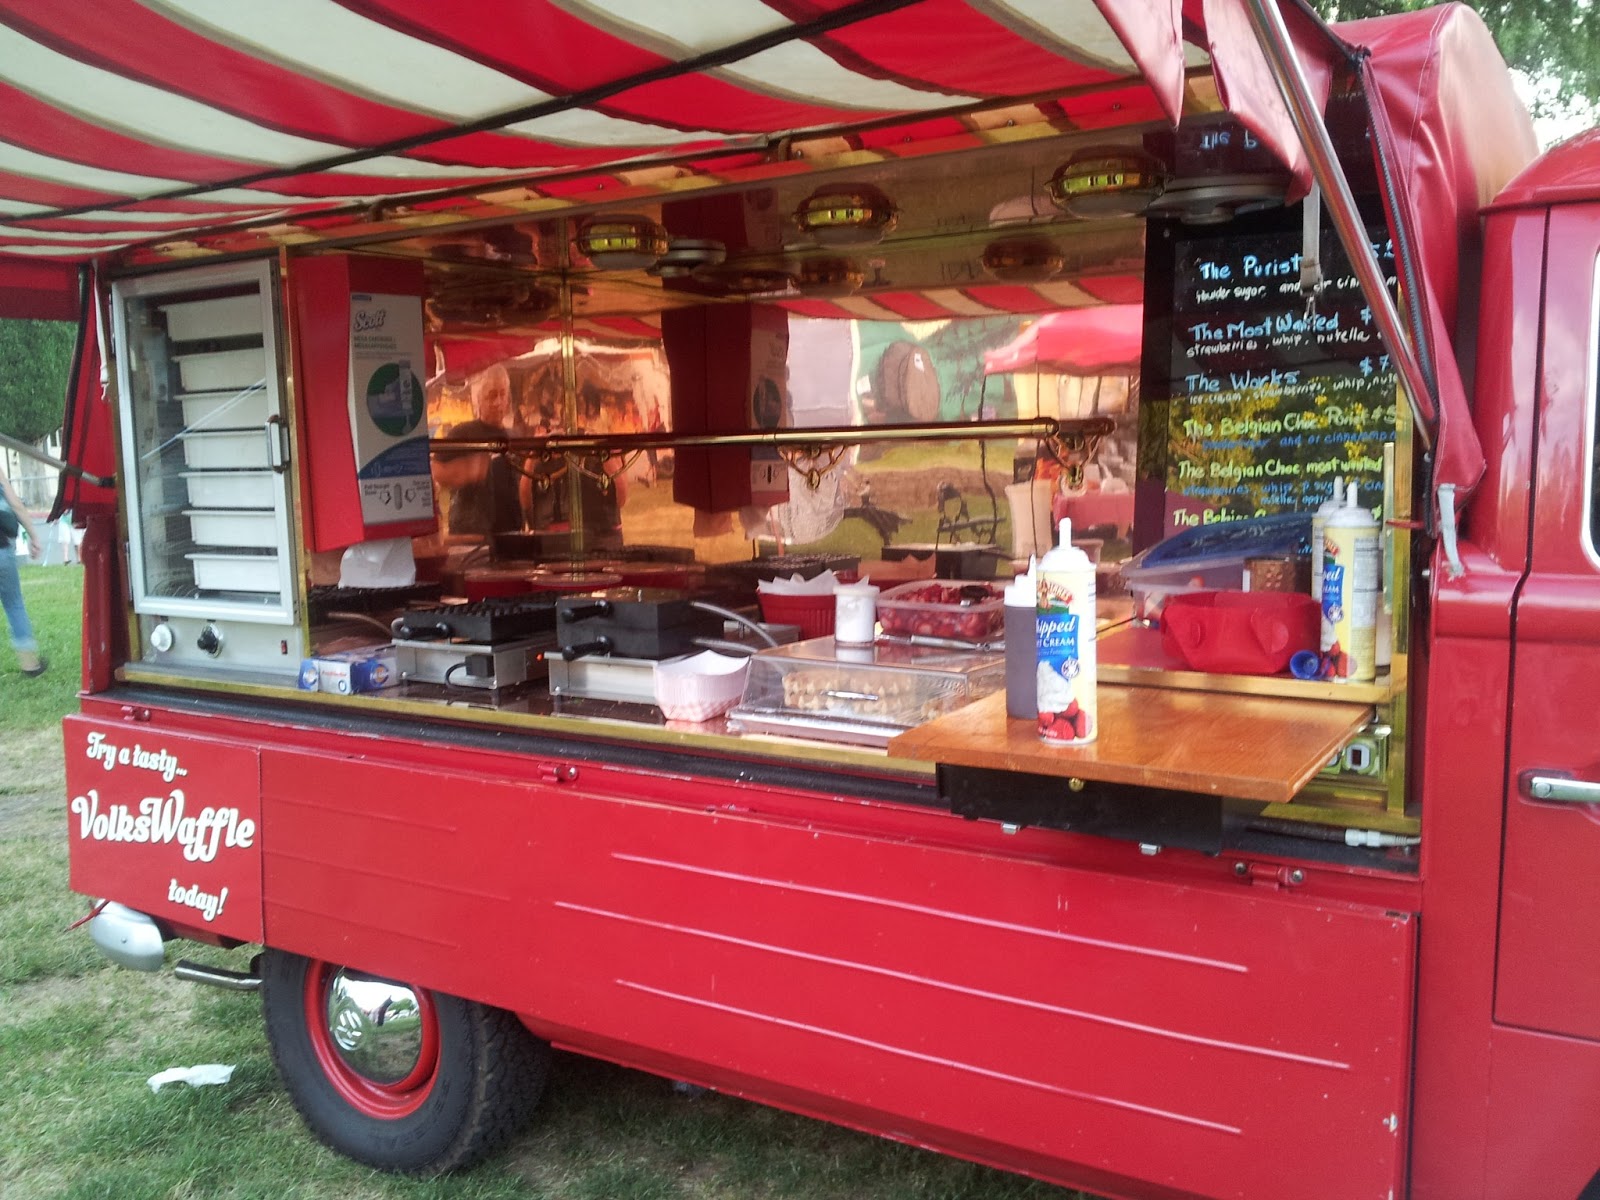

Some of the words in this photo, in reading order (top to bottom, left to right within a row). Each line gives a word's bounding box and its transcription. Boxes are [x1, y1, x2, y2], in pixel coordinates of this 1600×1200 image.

[1199, 262, 1231, 279] The
[1243, 253, 1304, 277] Purist
[1187, 322, 1224, 341] The
[1226, 316, 1272, 339] Most
[1317, 327, 1370, 343] nutella
[1185, 372, 1220, 394] The
[1230, 368, 1300, 391] Works
[1183, 418, 1213, 438] The
[1221, 416, 1281, 438] Belgian
[1178, 460, 1205, 479] The
[1210, 459, 1263, 482] Belgian
[1265, 459, 1300, 476] Choc
[1173, 508, 1199, 526] The
[1043, 637, 1075, 648] CREAM
[86, 732, 116, 771] Try
[118, 748, 130, 765] a
[132, 744, 188, 782] tasty...
[71, 789, 256, 862] VolksWaffle
[167, 878, 229, 922] today!
